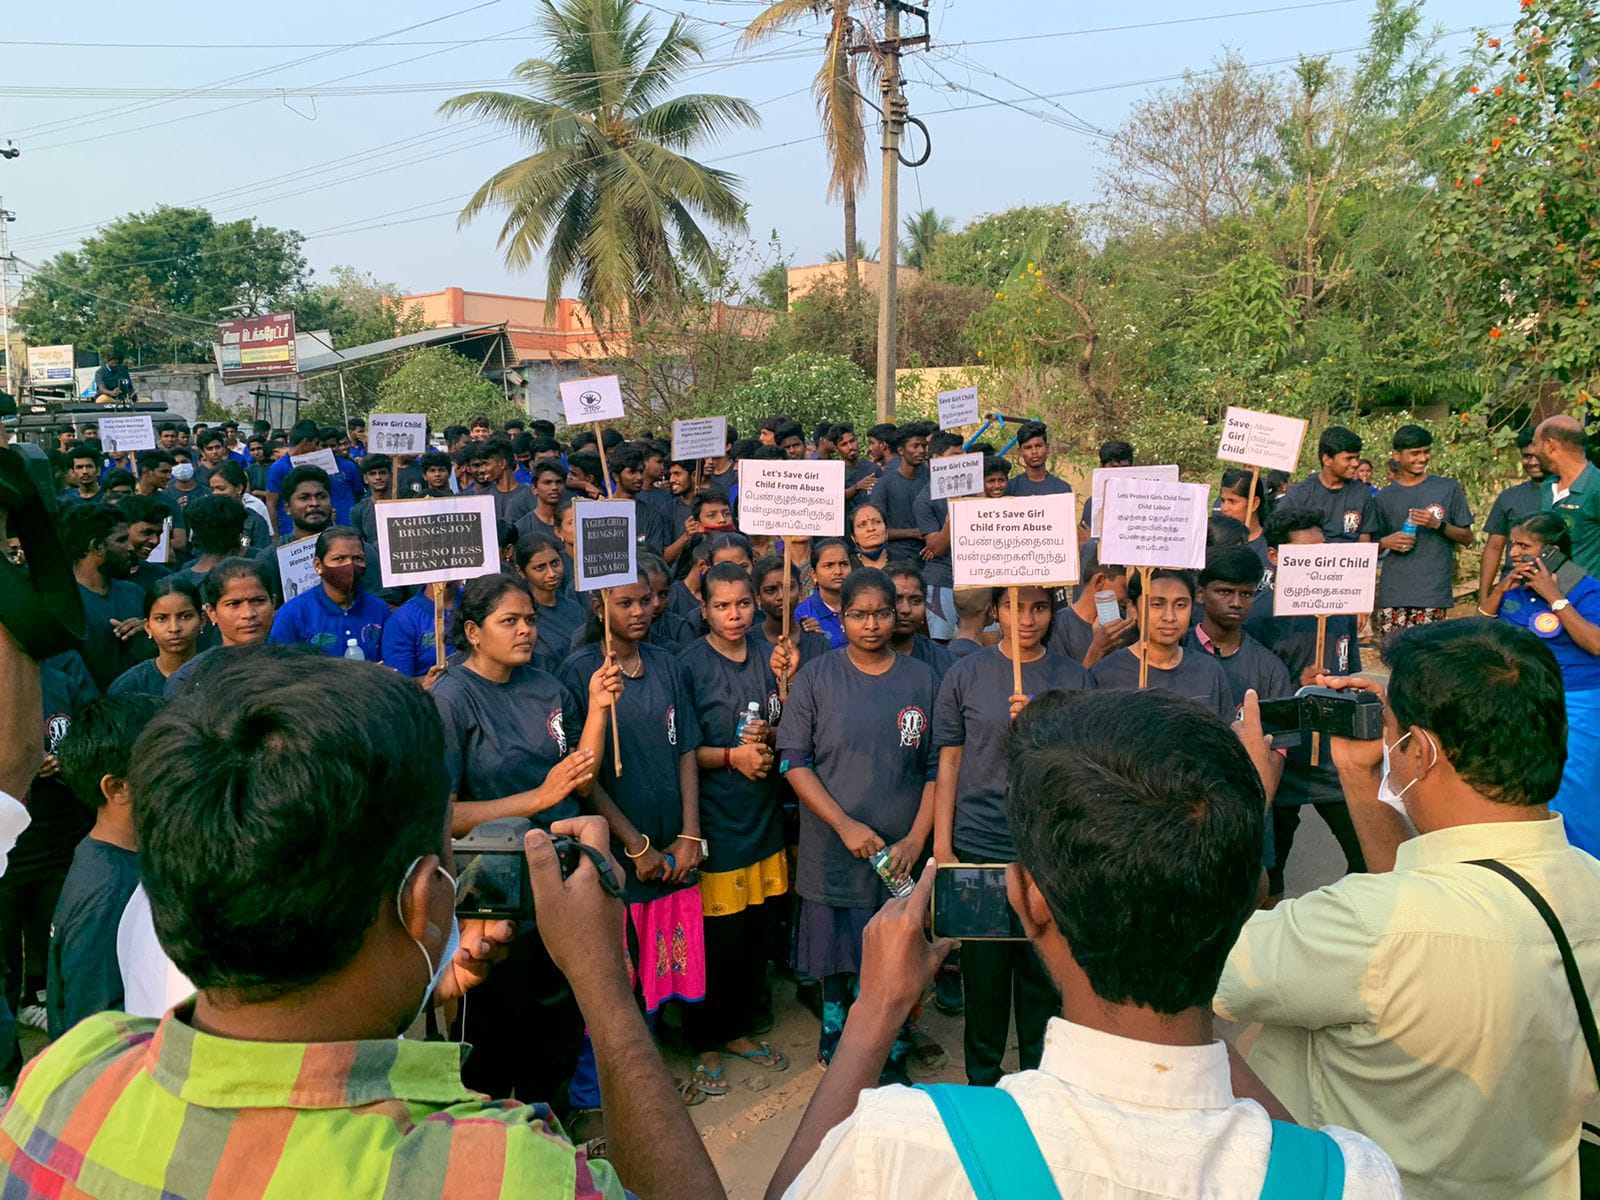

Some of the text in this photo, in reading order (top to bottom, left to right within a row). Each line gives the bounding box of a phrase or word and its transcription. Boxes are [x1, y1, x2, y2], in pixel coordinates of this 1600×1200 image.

[1228, 418, 1250, 429] Save
[1228, 432, 1245, 441] Girl
[1222, 444, 1245, 454] Child
[784, 471, 802, 479] Save
[403, 517, 435, 526] GIRL
[437, 514, 476, 523] CHILD
[590, 520, 606, 528] GIRL
[753, 520, 820, 531] பாதுகாப்போம்
[399, 525, 472, 537] BRINGS JOY
[1023, 523, 1052, 531] Abuse
[588, 529, 612, 539] BRINGS
[392, 545, 482, 560] SHE'S NO LESS
[584, 554, 603, 563] SHE'S
[614, 552, 629, 560] LESS
[289, 556, 309, 566] Women
[400, 560, 437, 570] THAN
[451, 557, 476, 566] BOY
[1283, 556, 1369, 568] Save Girl Child
[589, 565, 608, 574] THAN
[613, 563, 626, 571] BOY
[970, 566, 1050, 579] பாதுகாப்போம்
[1284, 585, 1362, 597] குழந்தைகளை
